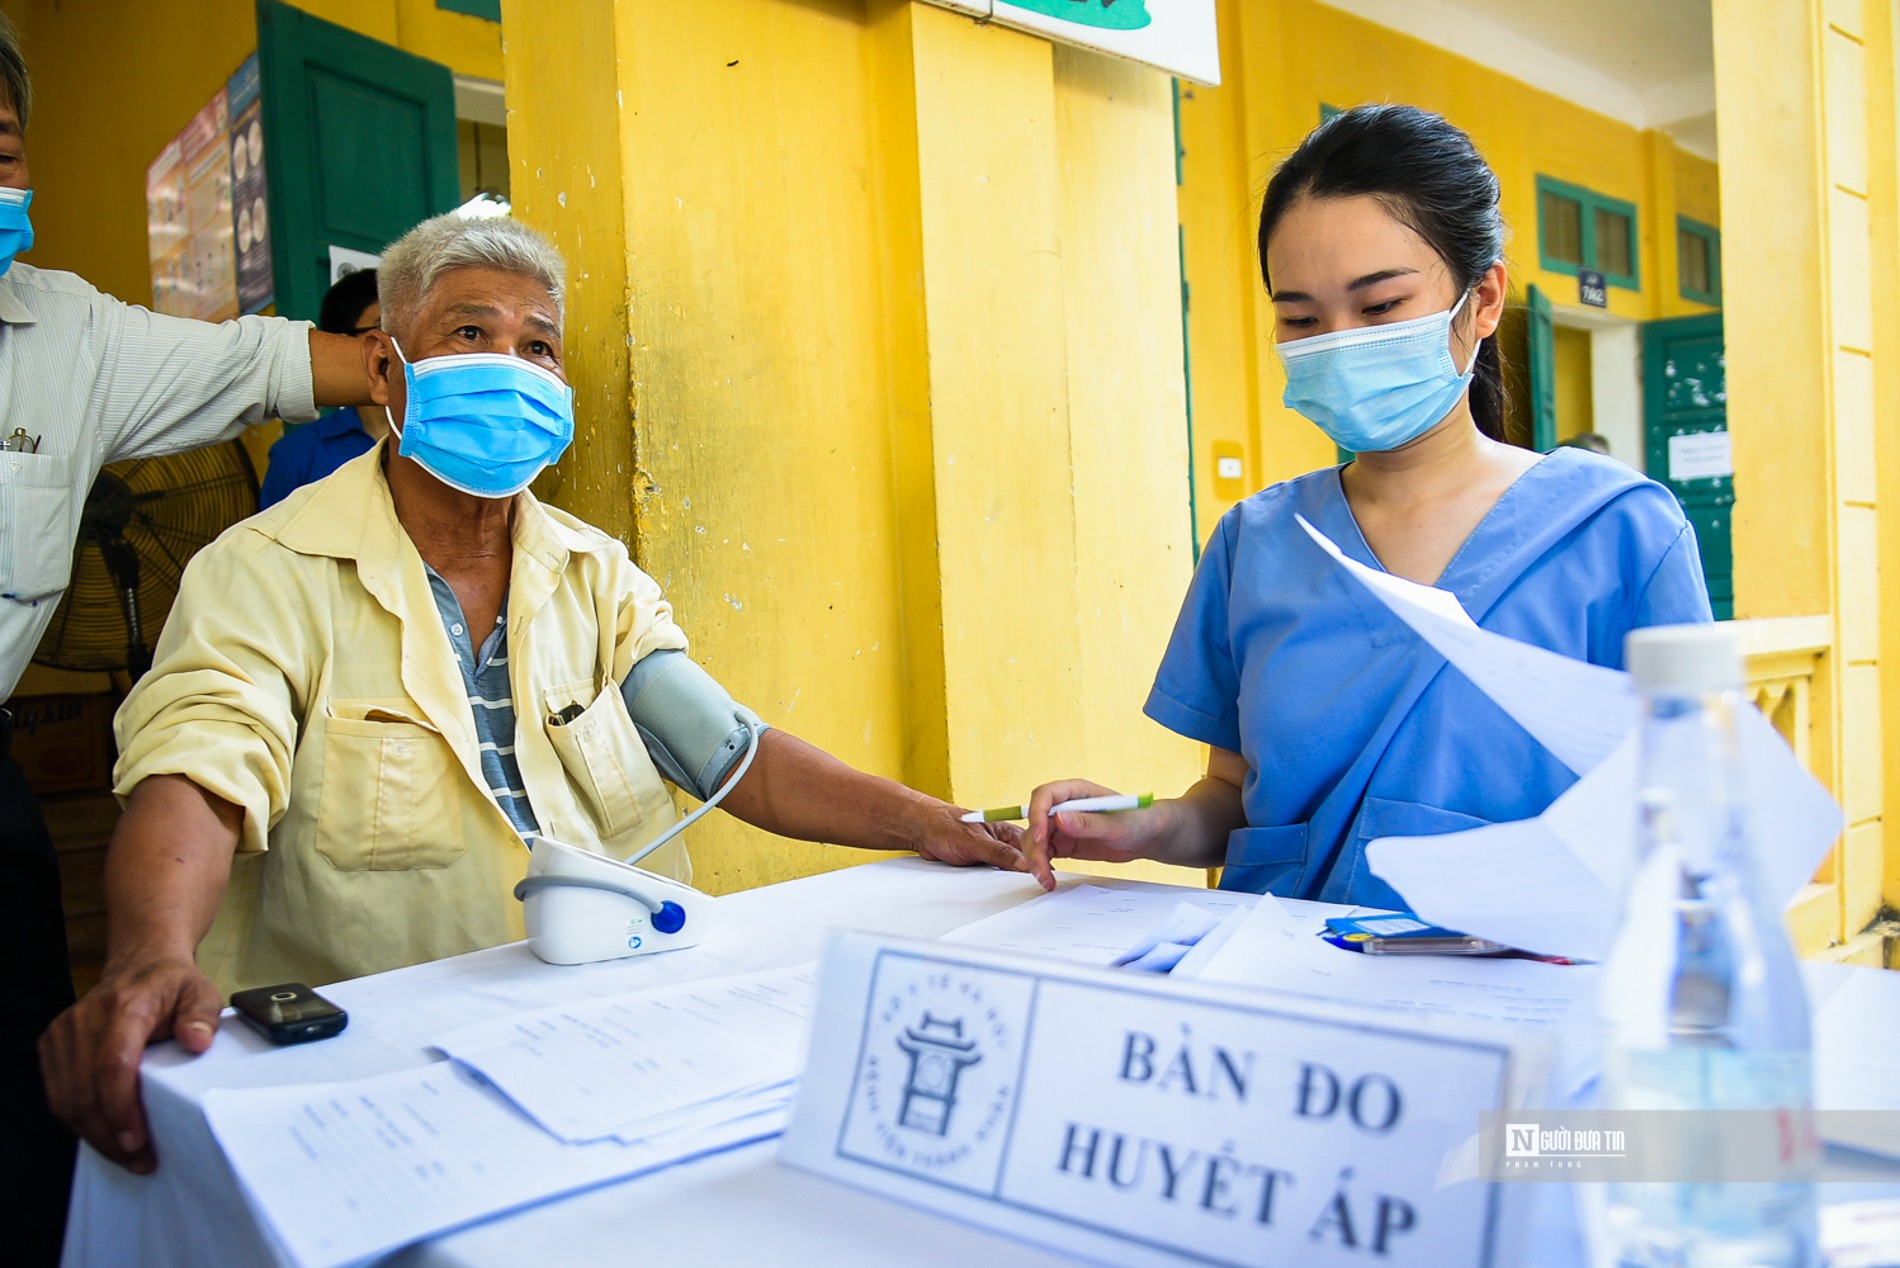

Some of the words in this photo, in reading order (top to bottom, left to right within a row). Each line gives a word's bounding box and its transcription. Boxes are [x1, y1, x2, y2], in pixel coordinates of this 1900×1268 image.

[1119, 1022, 1256, 1102] BÀN
[1294, 1059, 1403, 1134] ĐO
[1056, 1120, 1296, 1226] HUYẾT
[1308, 1165, 1418, 1257] ÁP
